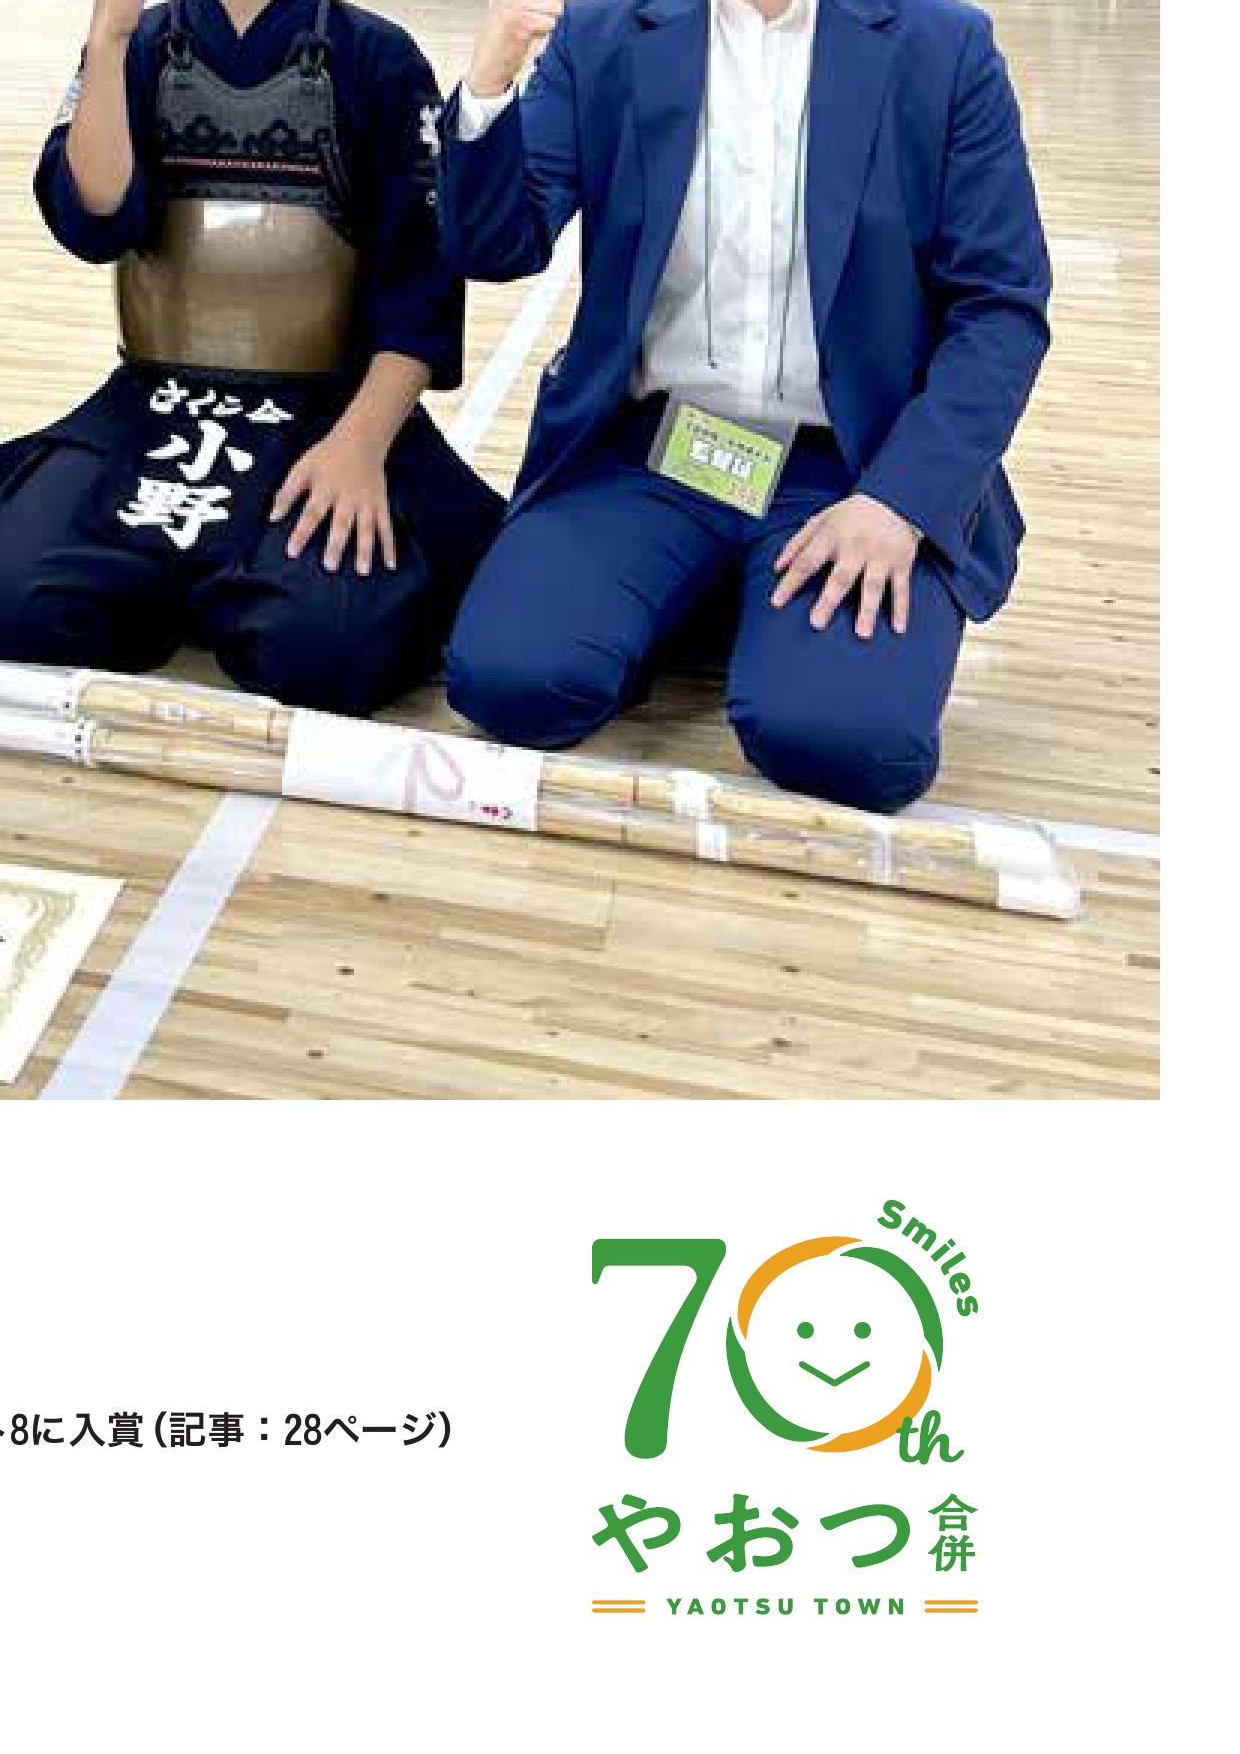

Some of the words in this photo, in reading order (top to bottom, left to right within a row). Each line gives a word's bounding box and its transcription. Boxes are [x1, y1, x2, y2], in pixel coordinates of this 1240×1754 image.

[150, 379, 294, 423] さくら会
[117, 419, 255, 550] 小野
